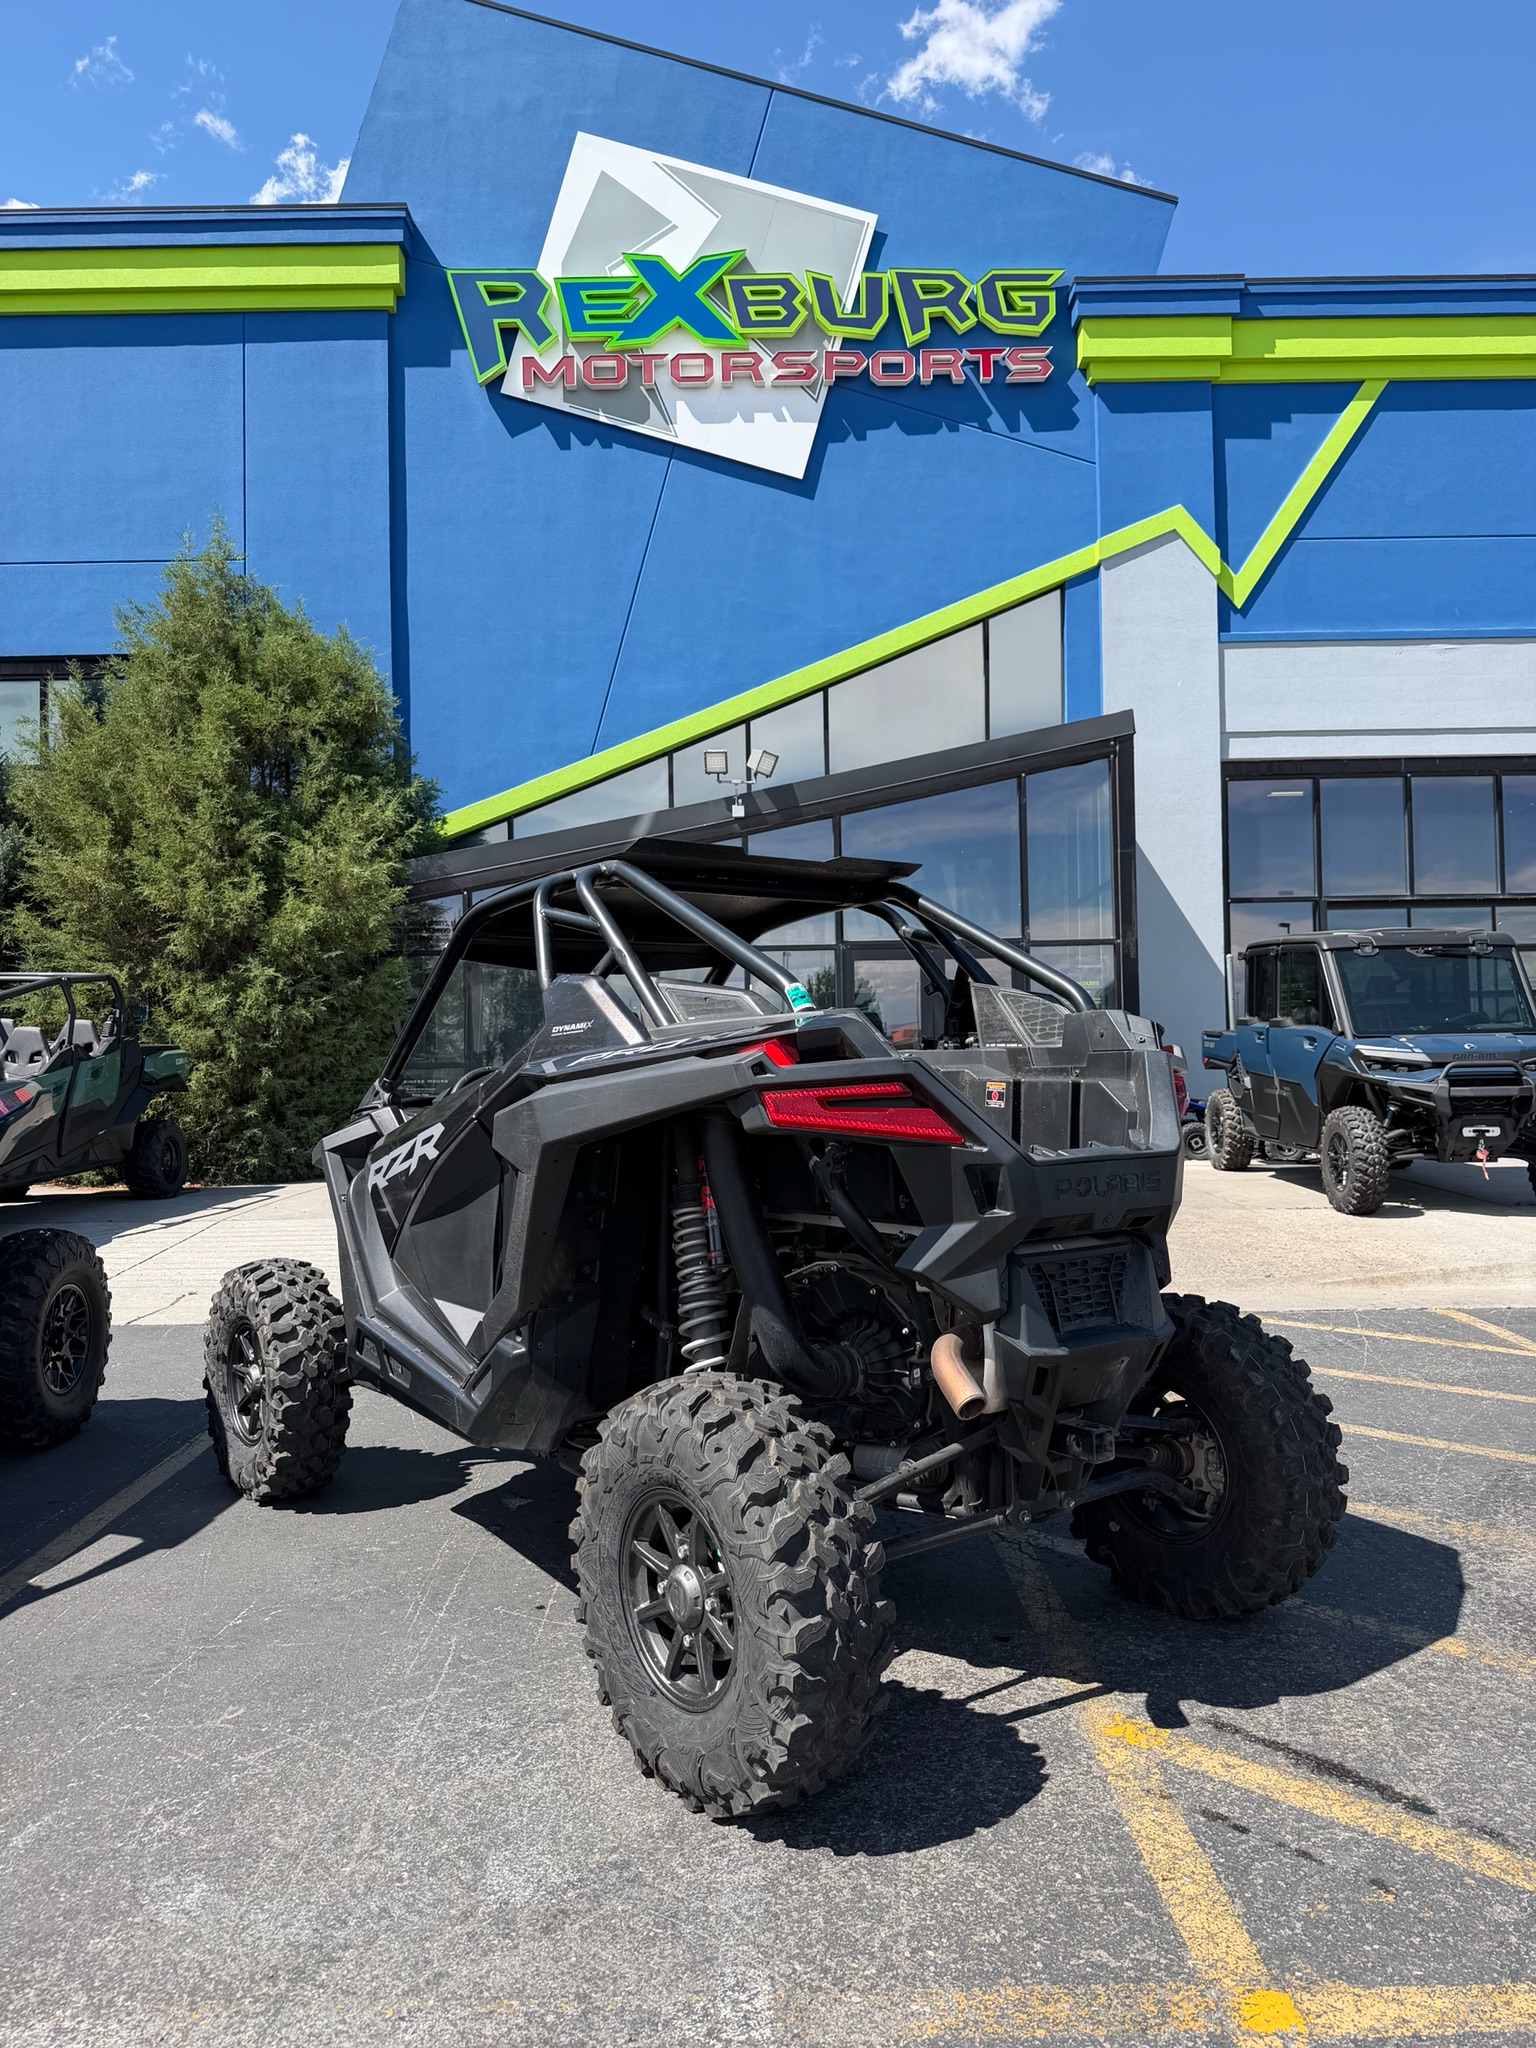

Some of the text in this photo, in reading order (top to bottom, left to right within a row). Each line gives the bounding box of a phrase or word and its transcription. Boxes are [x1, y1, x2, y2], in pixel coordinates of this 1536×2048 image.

[445, 249, 1066, 386] REXBURG
[521, 346, 1055, 391] MOTORSPORTS
[551, 1019, 595, 1034] DYNAMIX
[367, 1122, 446, 1195] RZR
[1055, 1171, 1162, 1201] POLARIS
